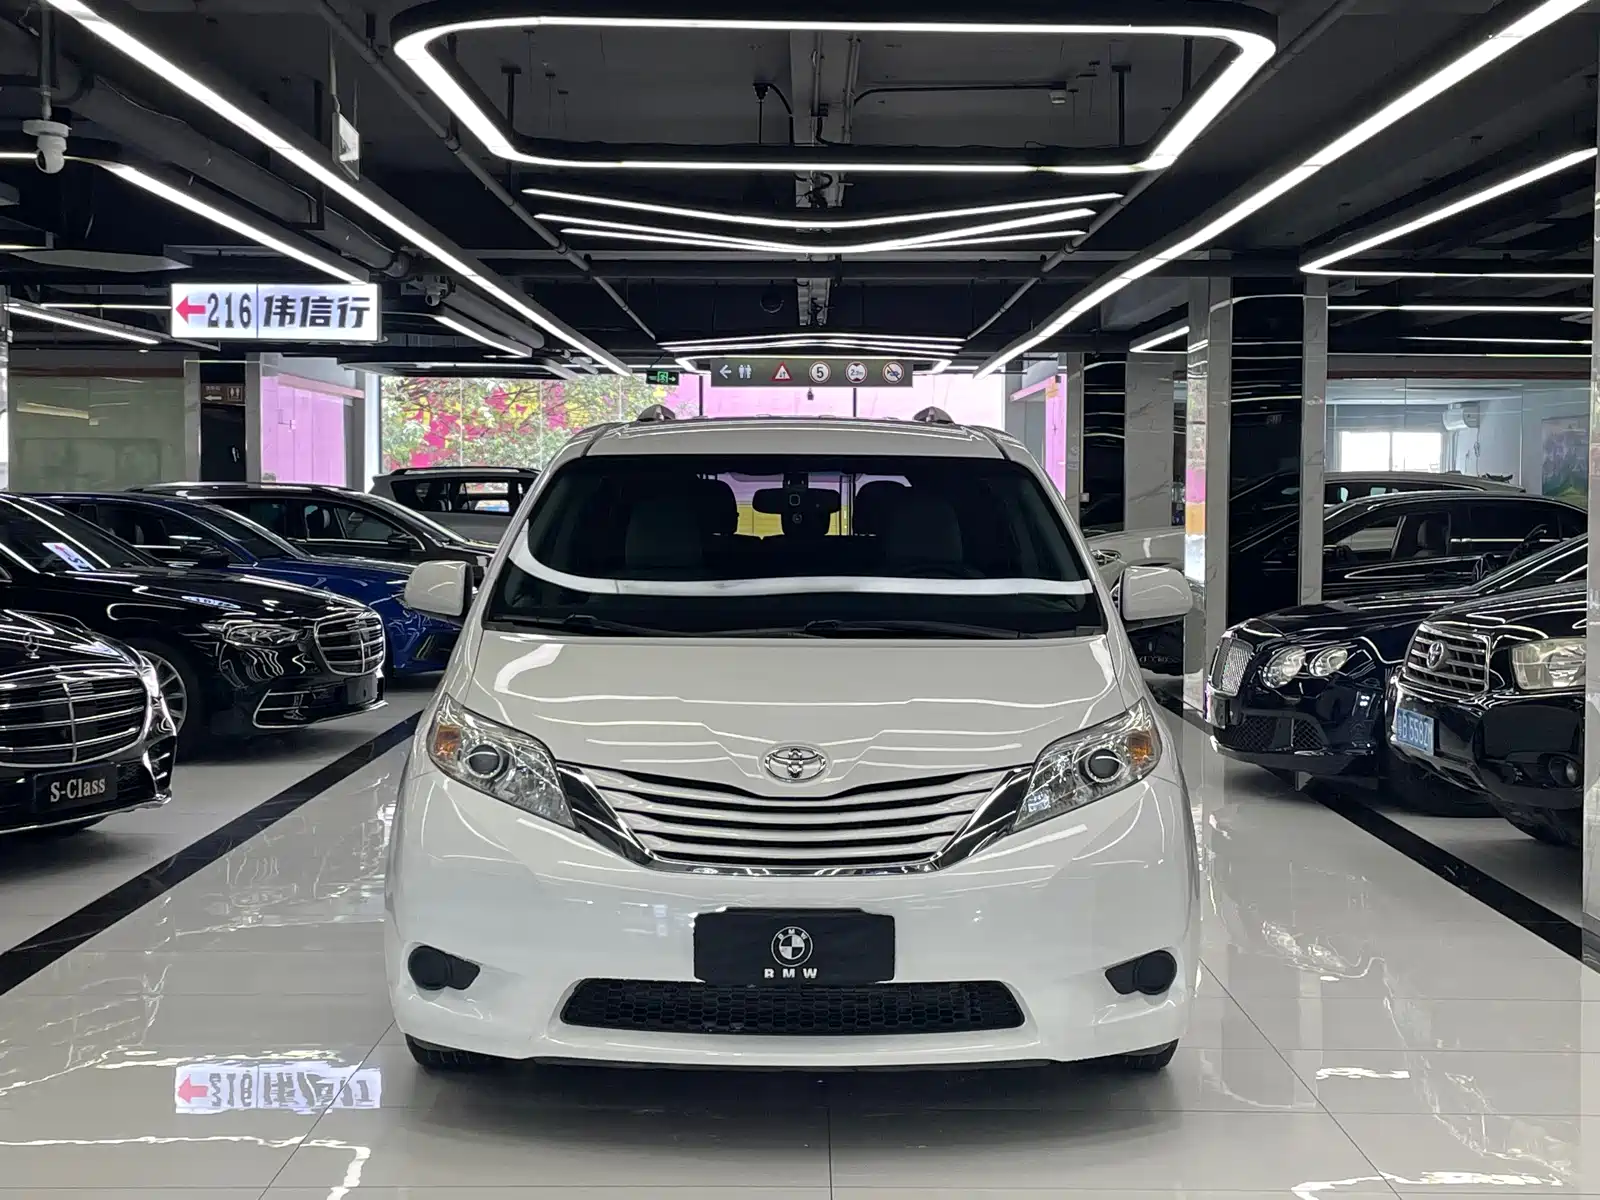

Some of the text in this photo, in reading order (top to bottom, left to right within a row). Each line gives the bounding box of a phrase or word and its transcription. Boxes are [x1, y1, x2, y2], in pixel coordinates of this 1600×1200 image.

[206, 292, 371, 329] 216 伟信行
[816, 366, 825, 379] 5
[49, 777, 106, 803] S-Class
